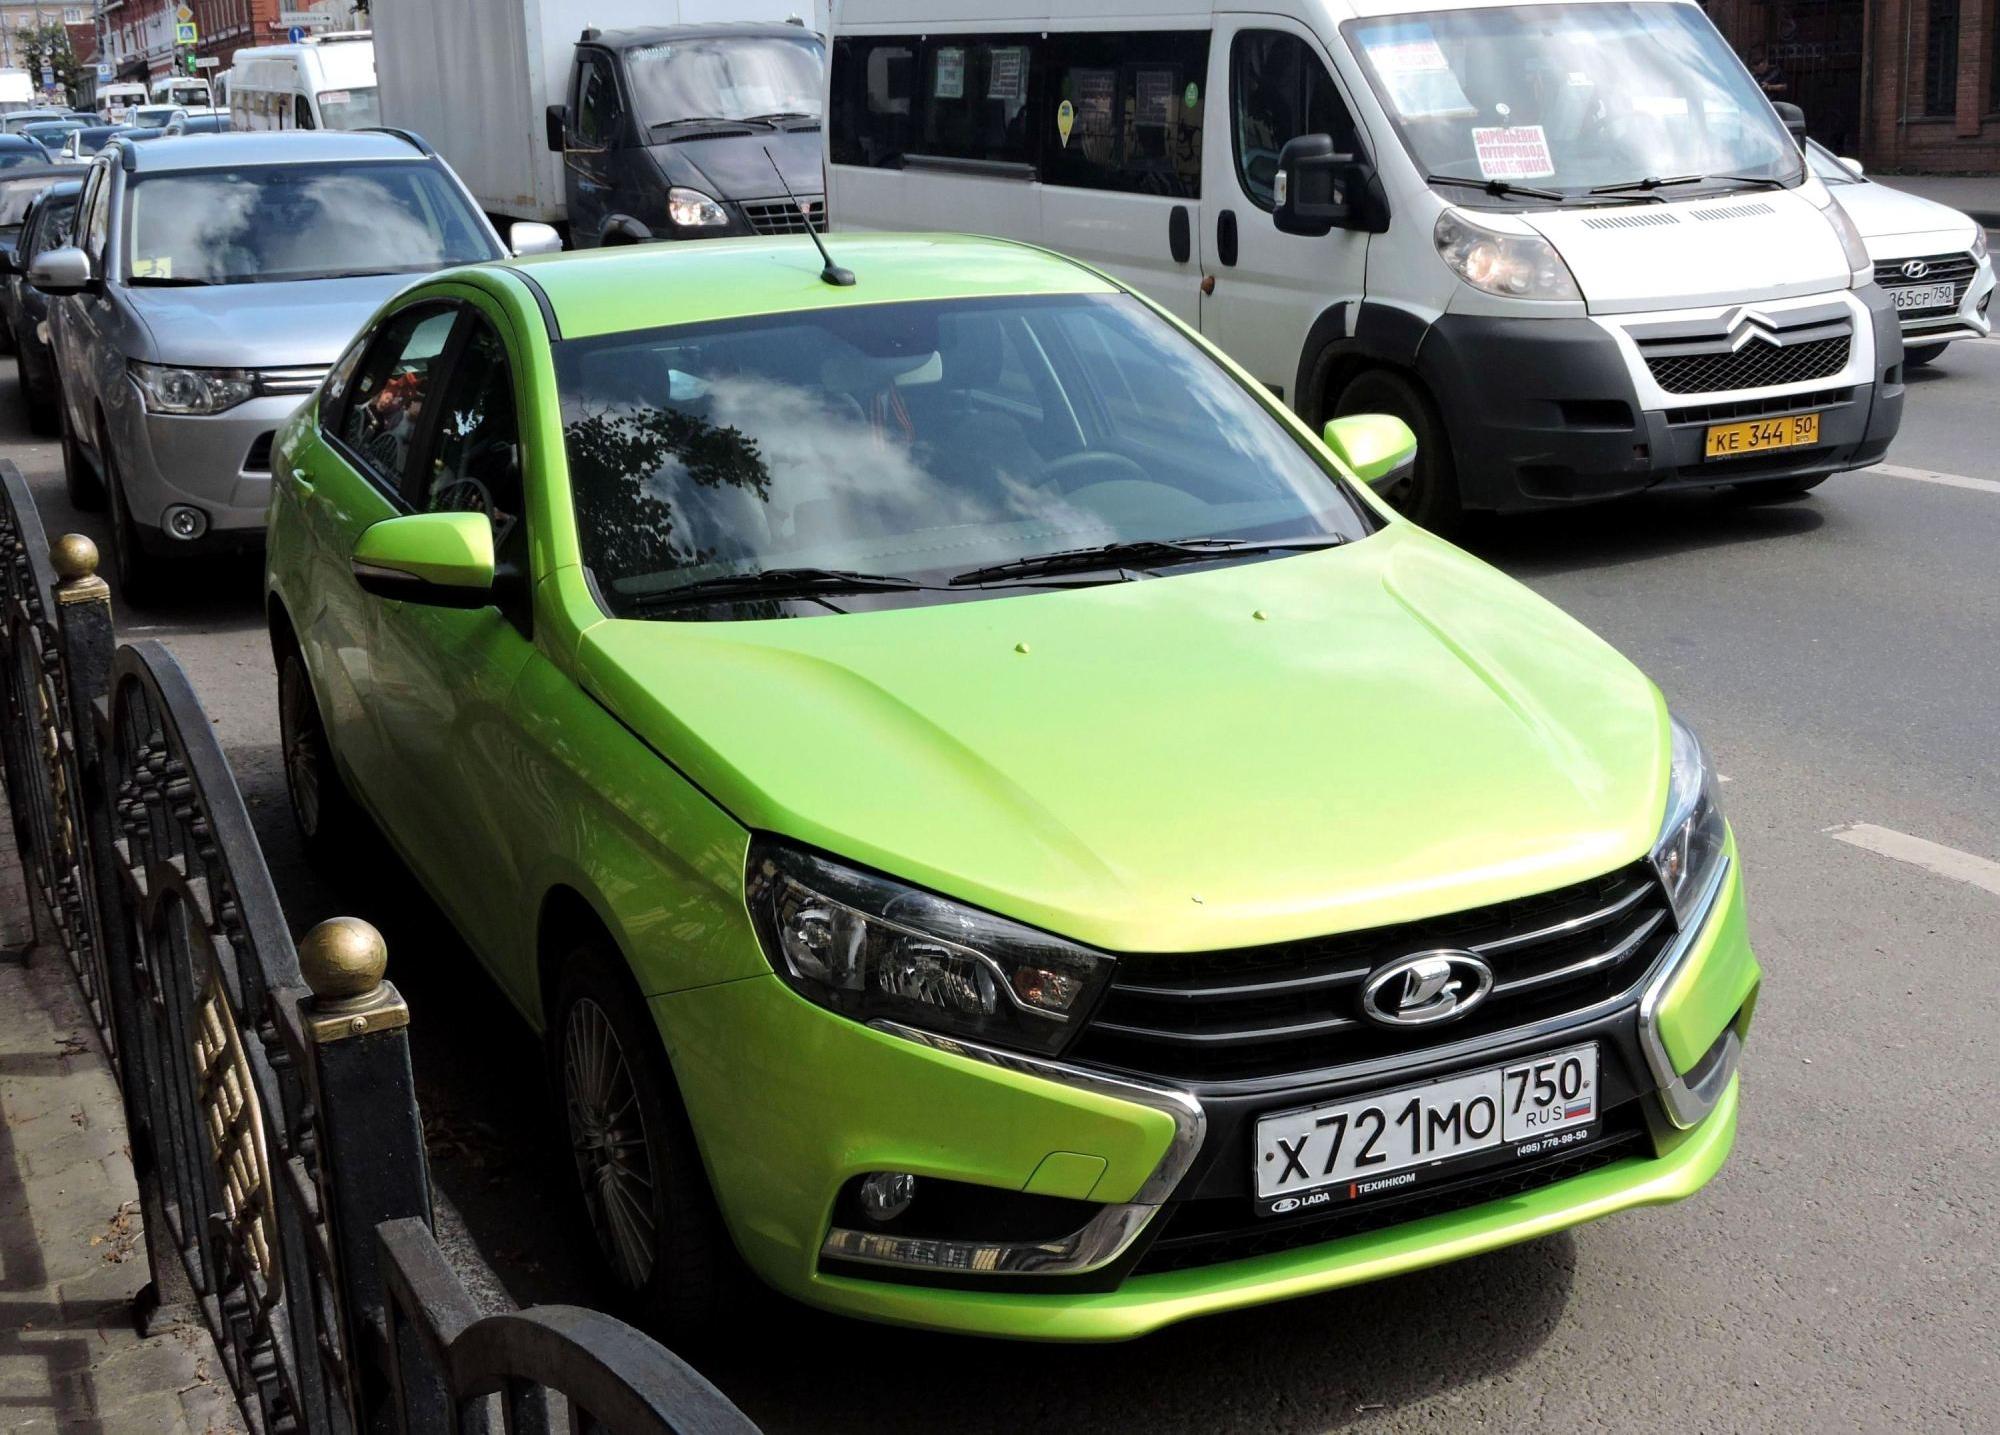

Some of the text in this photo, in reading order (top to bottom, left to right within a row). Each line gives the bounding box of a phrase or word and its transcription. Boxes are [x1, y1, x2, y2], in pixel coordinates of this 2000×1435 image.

[1748, 422, 1783, 446] 344
[1795, 417, 1813, 434] 50
[1506, 1057, 1582, 1115] 750
[1525, 1105, 1563, 1128] RUS
[1517, 1142, 1541, 1157] (495)
[1357, 1172, 1417, 1194] ТЕХИНКОМ
[1302, 1193, 1330, 1206] LADA
